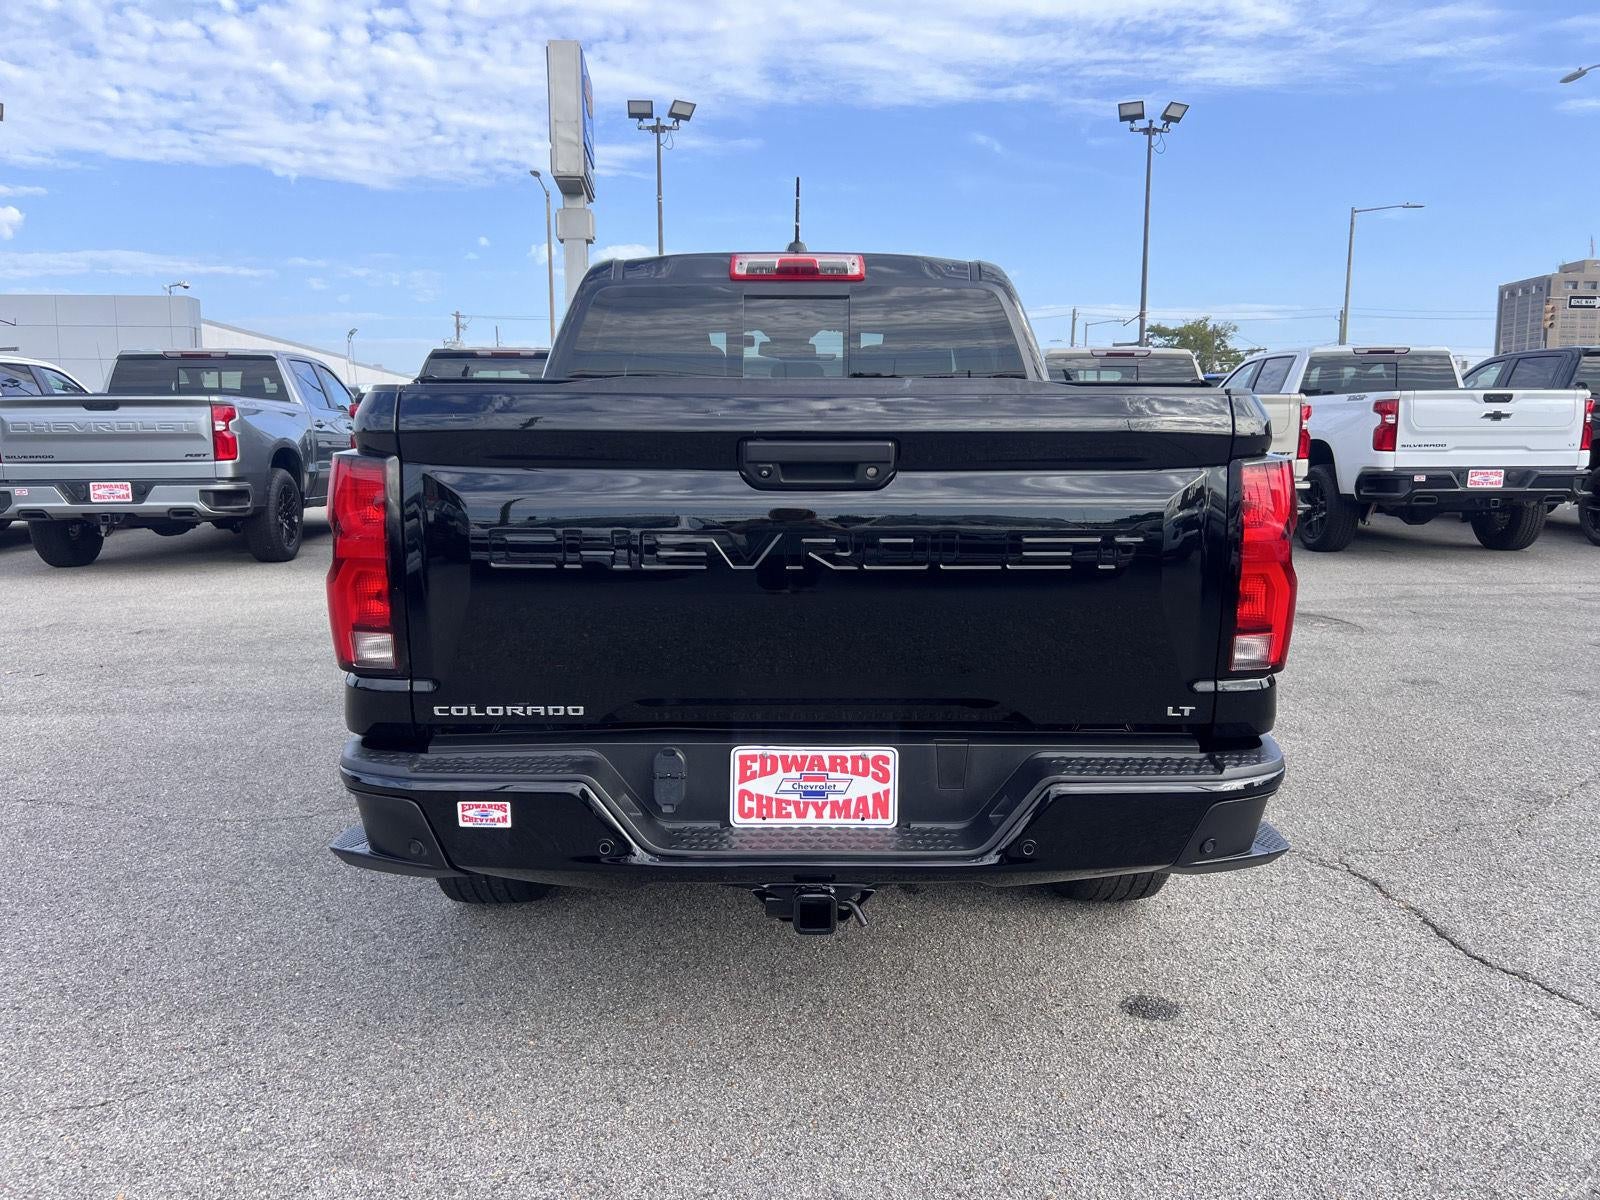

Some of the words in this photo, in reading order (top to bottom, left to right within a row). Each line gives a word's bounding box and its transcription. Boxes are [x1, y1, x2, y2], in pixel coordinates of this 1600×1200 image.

[9, 420, 196, 433] CHEVROLET
[92, 492, 130, 500] CHEVYMAN
[488, 530, 1144, 570] CHEVROLET
[433, 706, 585, 716] COLORADO
[1167, 706, 1196, 716] LT
[738, 754, 891, 785] EDWARDS
[791, 782, 837, 790] Chevrolet
[461, 803, 508, 814] EDWARDS
[737, 788, 891, 820] CHEVYMAN
[461, 813, 508, 823] CHEVYMAN
